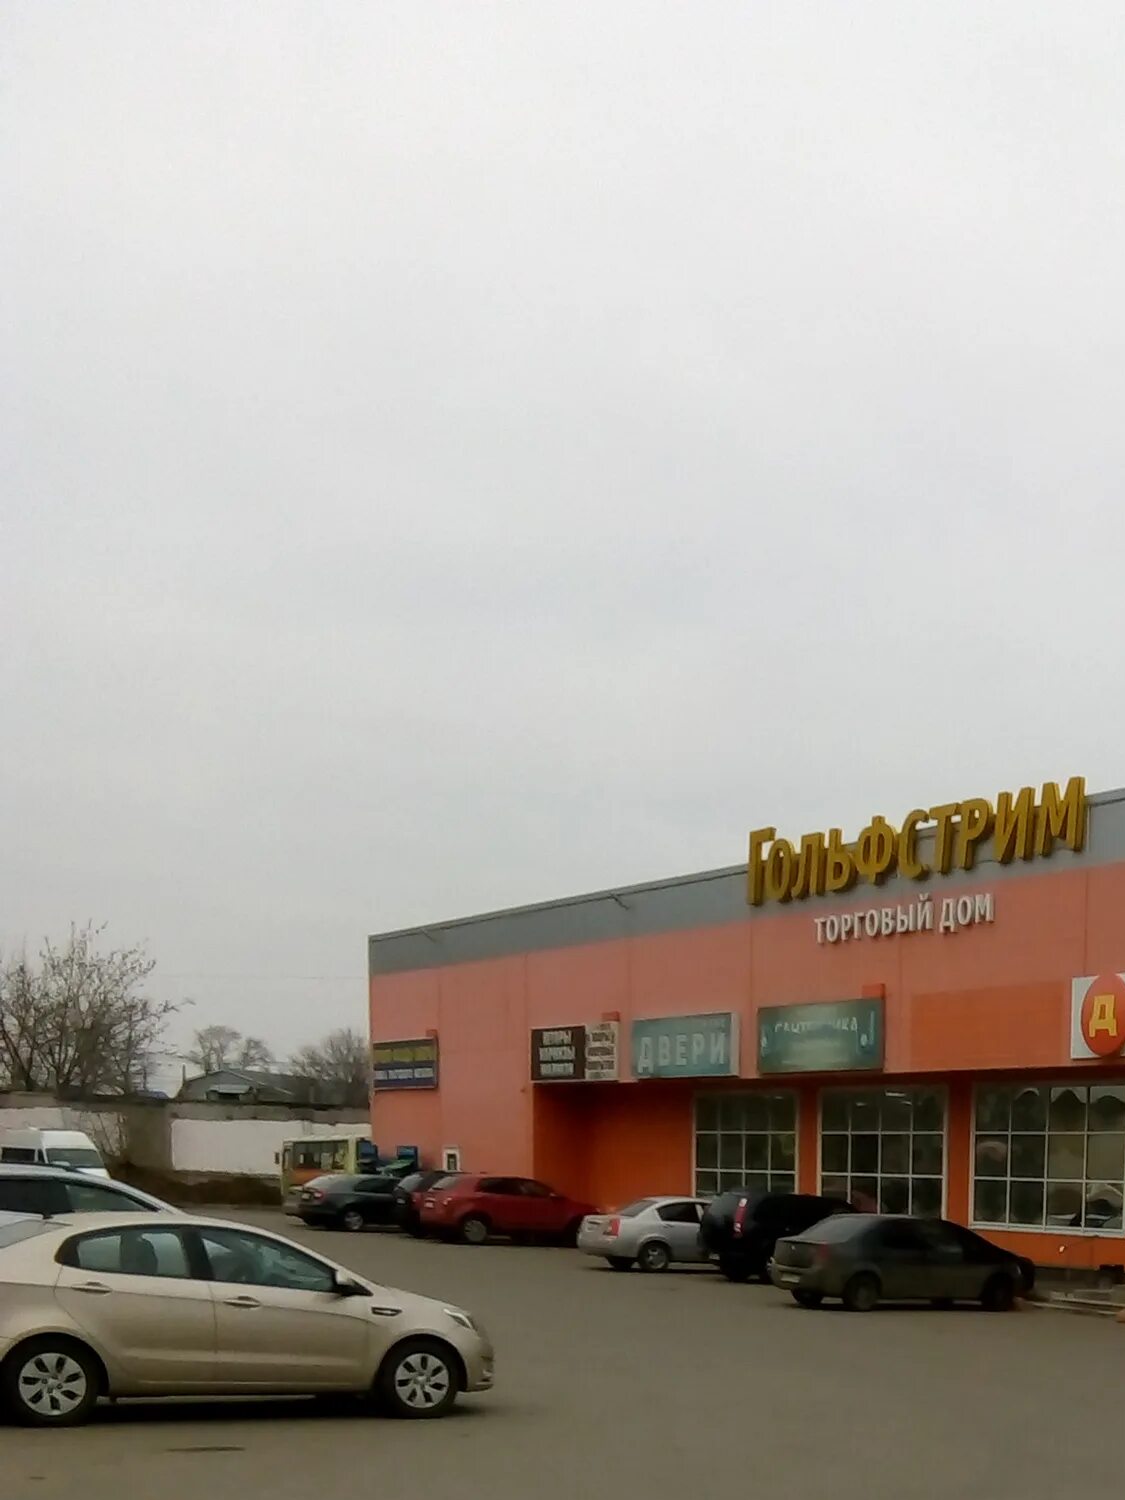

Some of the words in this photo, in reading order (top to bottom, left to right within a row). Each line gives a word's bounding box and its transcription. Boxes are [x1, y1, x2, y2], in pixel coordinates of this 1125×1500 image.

[748, 776, 1086, 906] ГОЛЬФСТРИМ
[814, 893, 934, 945] ТОРГОВЫЙ
[939, 893, 995, 934] ДОМ
[1088, 994, 1118, 1038] Д
[637, 1031, 726, 1074] ДВЕРИ
